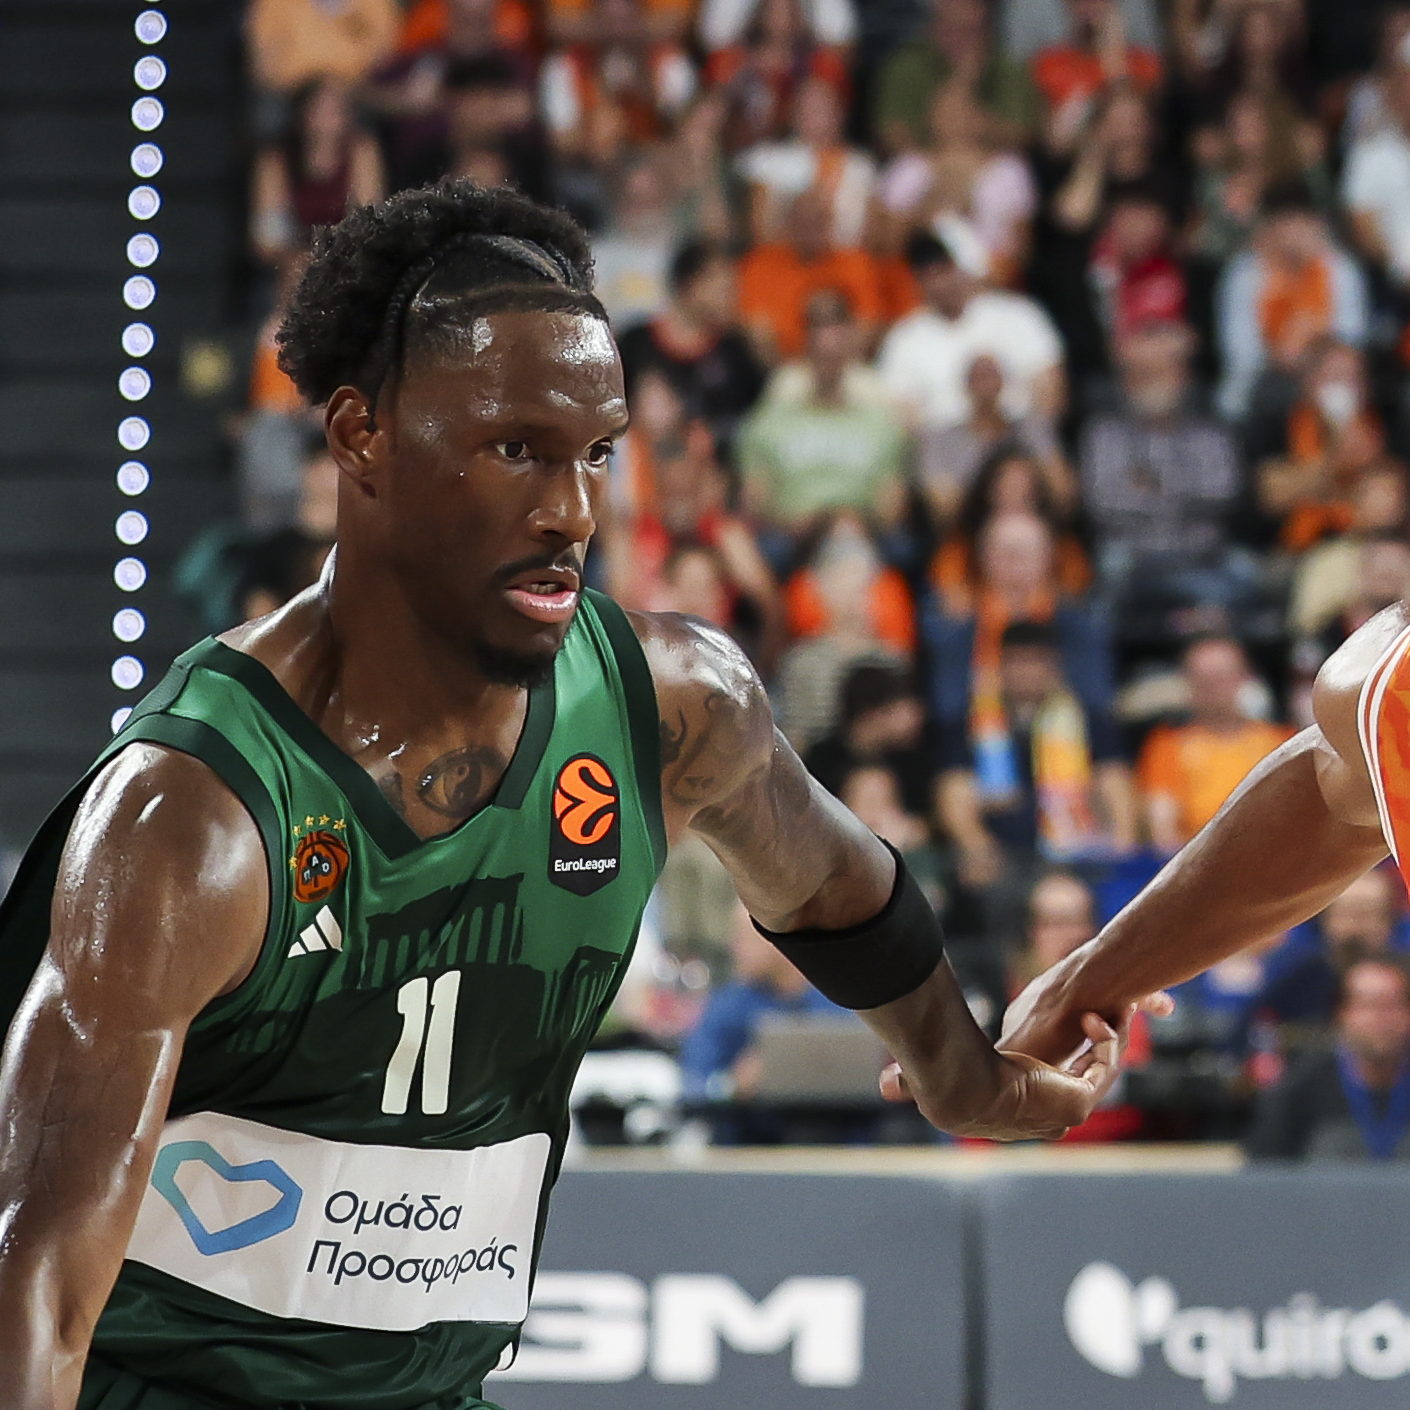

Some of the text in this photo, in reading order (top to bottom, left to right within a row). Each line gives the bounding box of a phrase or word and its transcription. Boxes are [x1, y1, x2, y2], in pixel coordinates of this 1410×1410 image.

[554, 857, 617, 874] EuroLeague
[382, 970, 461, 1115] 11
[323, 1190, 463, 1235] Ομάδα
[306, 1236, 518, 1293] Προσφοράς
